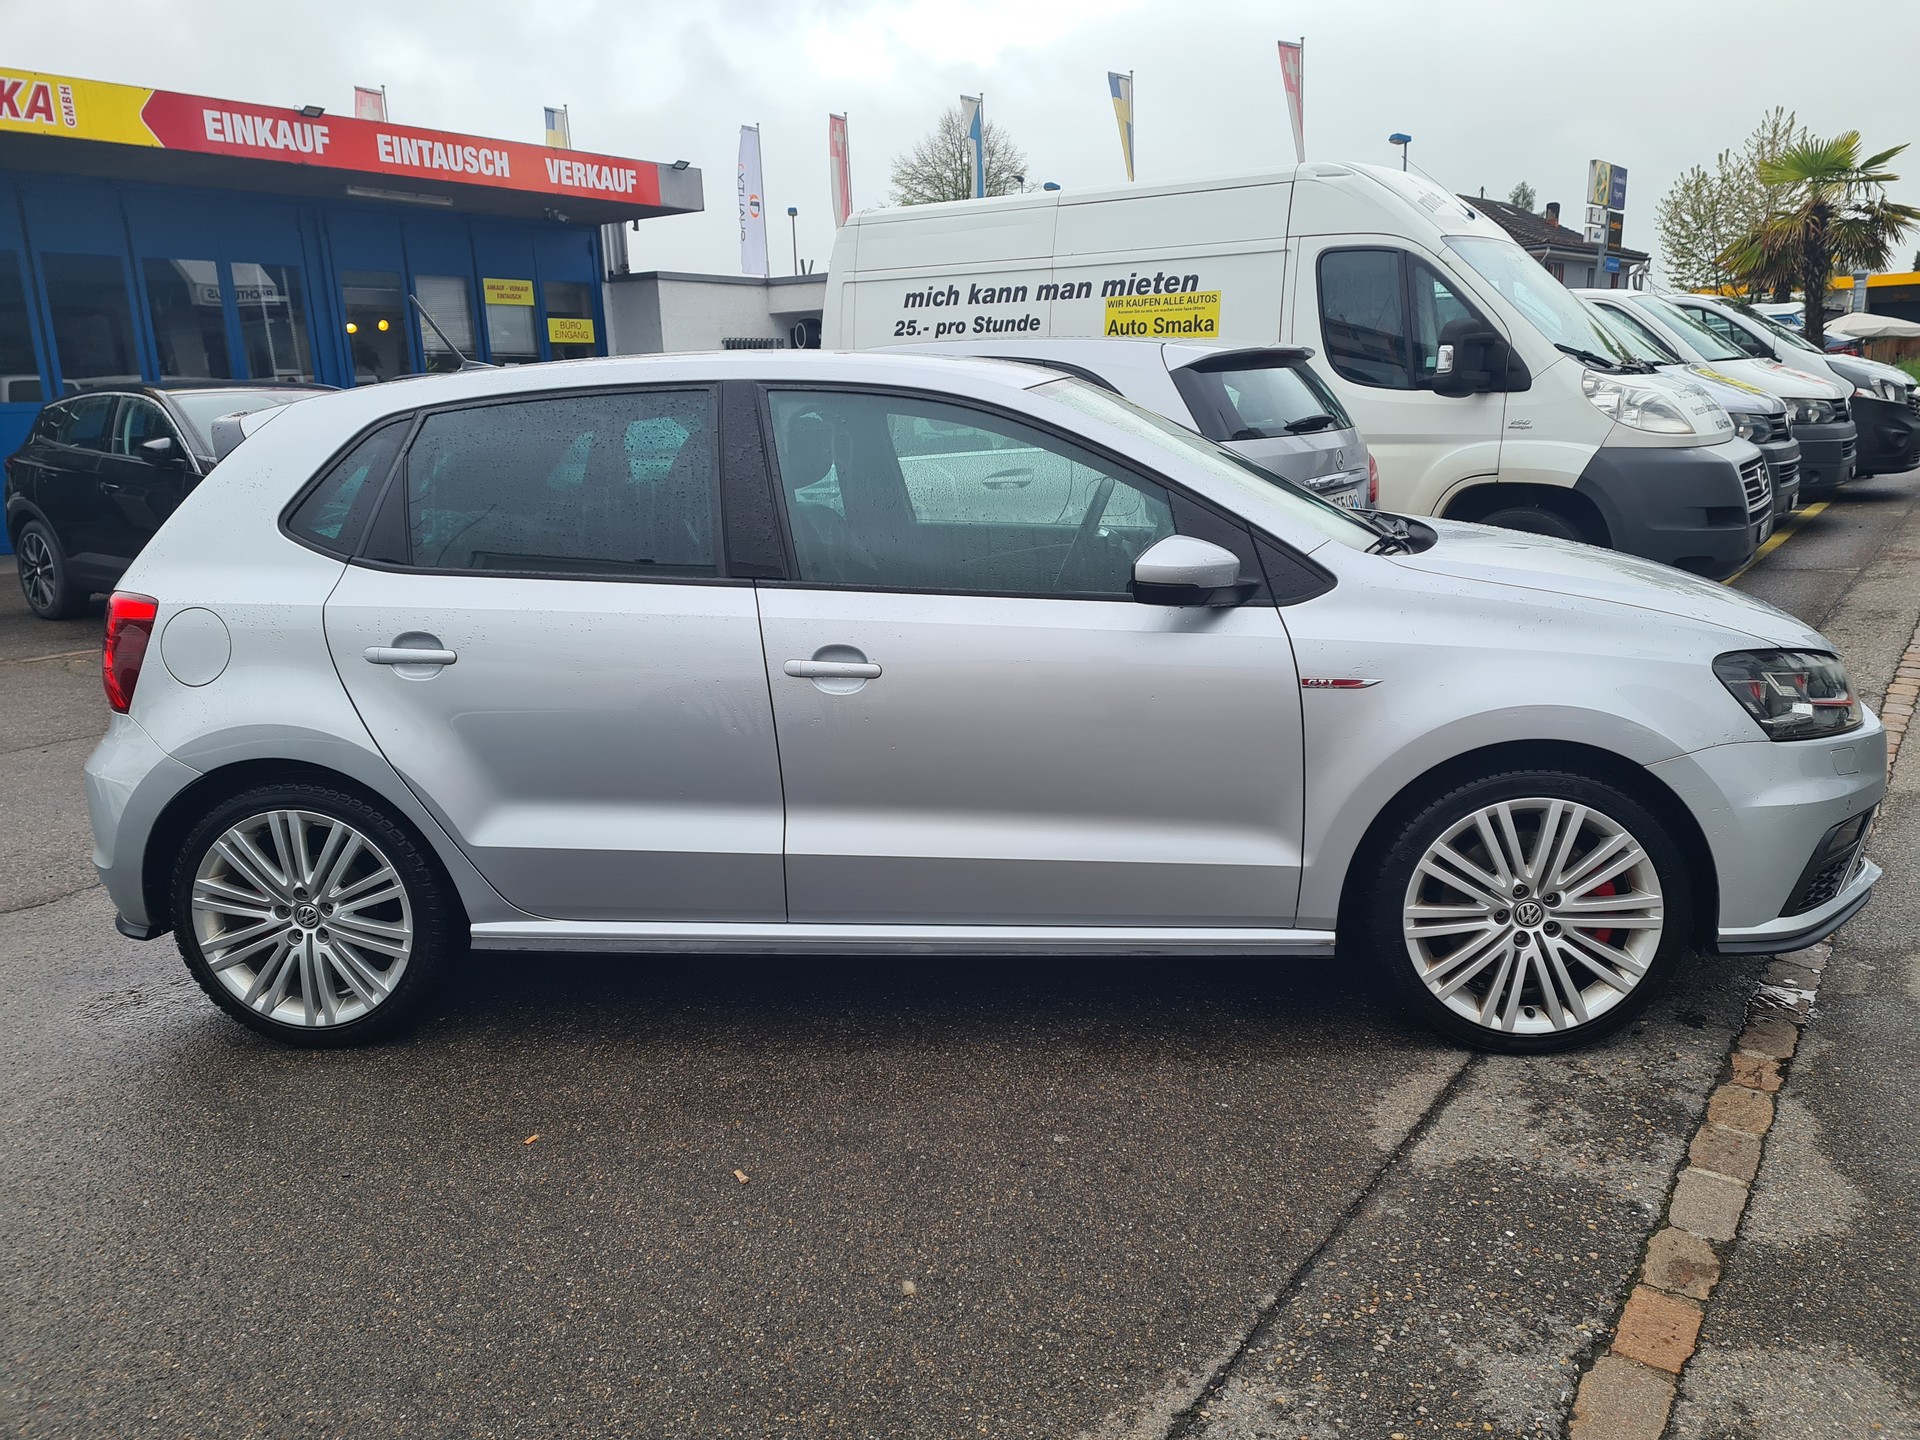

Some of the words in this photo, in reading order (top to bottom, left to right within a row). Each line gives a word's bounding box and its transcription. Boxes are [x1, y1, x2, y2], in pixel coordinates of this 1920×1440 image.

[59, 86, 76, 126] GMBH
[202, 109, 330, 154] EINKAUF
[376, 133, 511, 178] EINTAUSCH
[545, 157, 637, 193] VERKAUF
[509, 285, 529, 293] VERKAUF
[903, 284, 960, 308] mich
[967, 283, 1028, 305] kann
[1036, 280, 1093, 301] man
[1100, 272, 1199, 298] mieten
[1107, 300, 1124, 308] WIR
[1126, 298, 1161, 308] KAUFEN
[1163, 296, 1185, 306] ALLE
[1186, 294, 1218, 304] AUTOS
[555, 331, 589, 339] EINGANG
[560, 320, 582, 330] BÜRO
[934, 320, 967, 338] pro
[972, 314, 1041, 334] Stunde
[1107, 319, 1148, 336] Auto
[1153, 313, 1215, 334] Smaka
